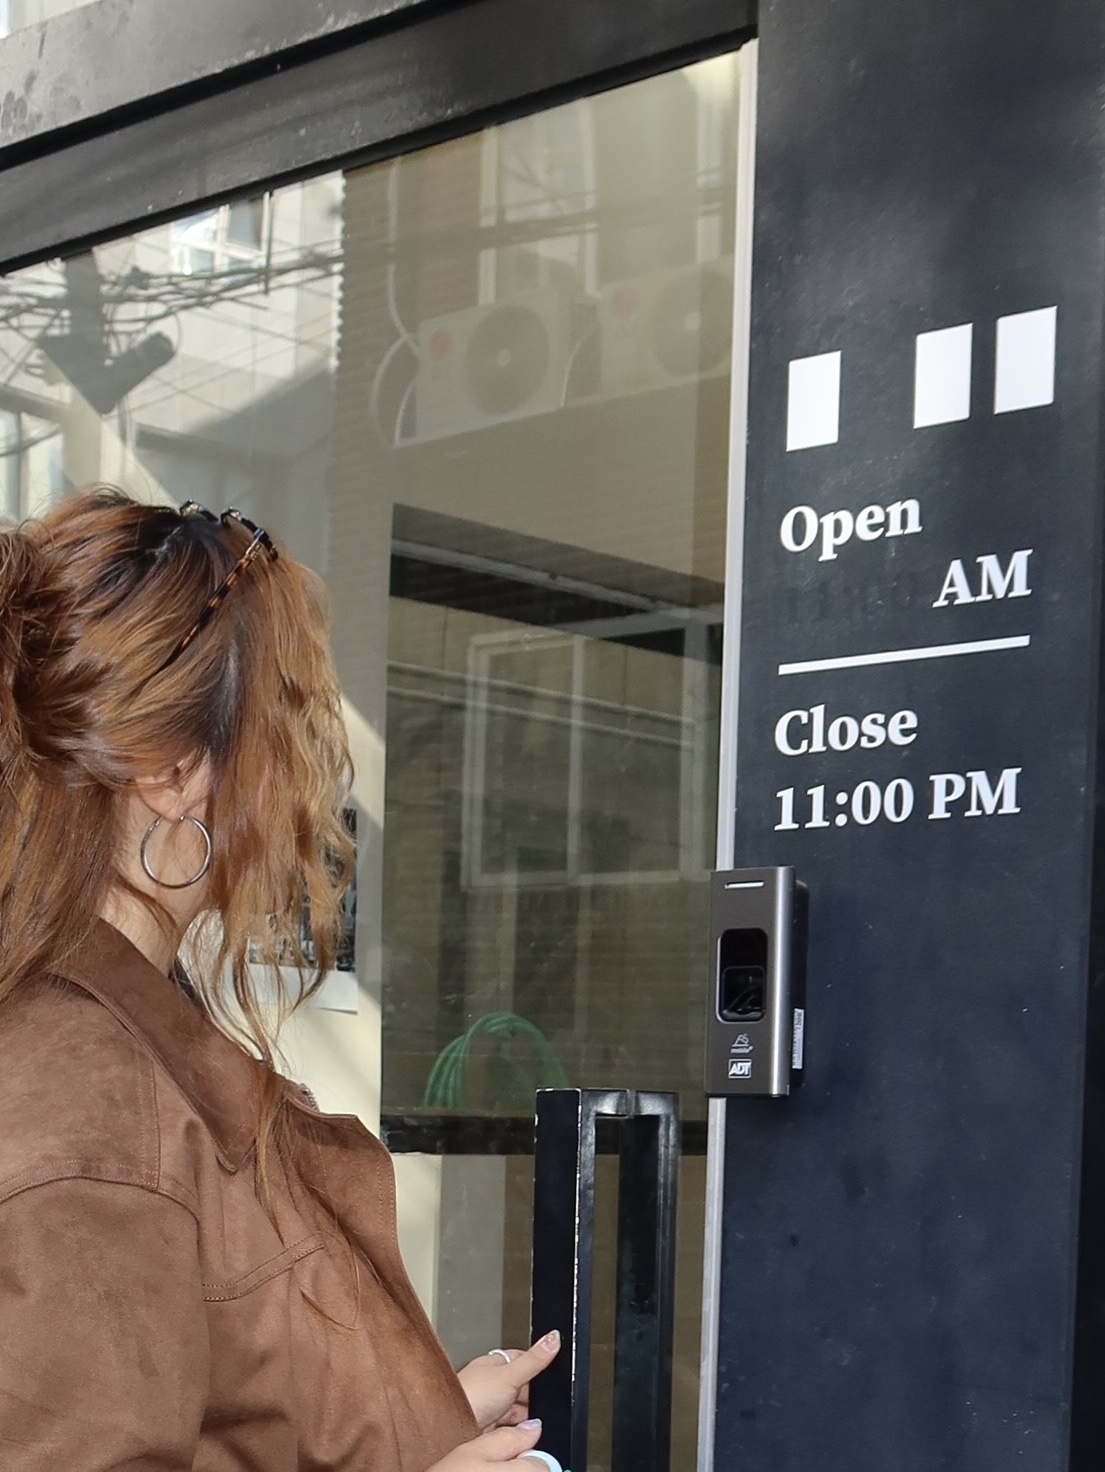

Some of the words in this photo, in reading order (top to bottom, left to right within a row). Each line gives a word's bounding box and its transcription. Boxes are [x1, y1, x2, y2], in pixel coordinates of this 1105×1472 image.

[779, 498, 923, 562] Open
[931, 549, 1034, 608] AM
[774, 704, 918, 756] Close
[774, 778, 914, 831] 11:00
[927, 768, 1022, 820] PM
[728, 1061, 752, 1076] ADT
